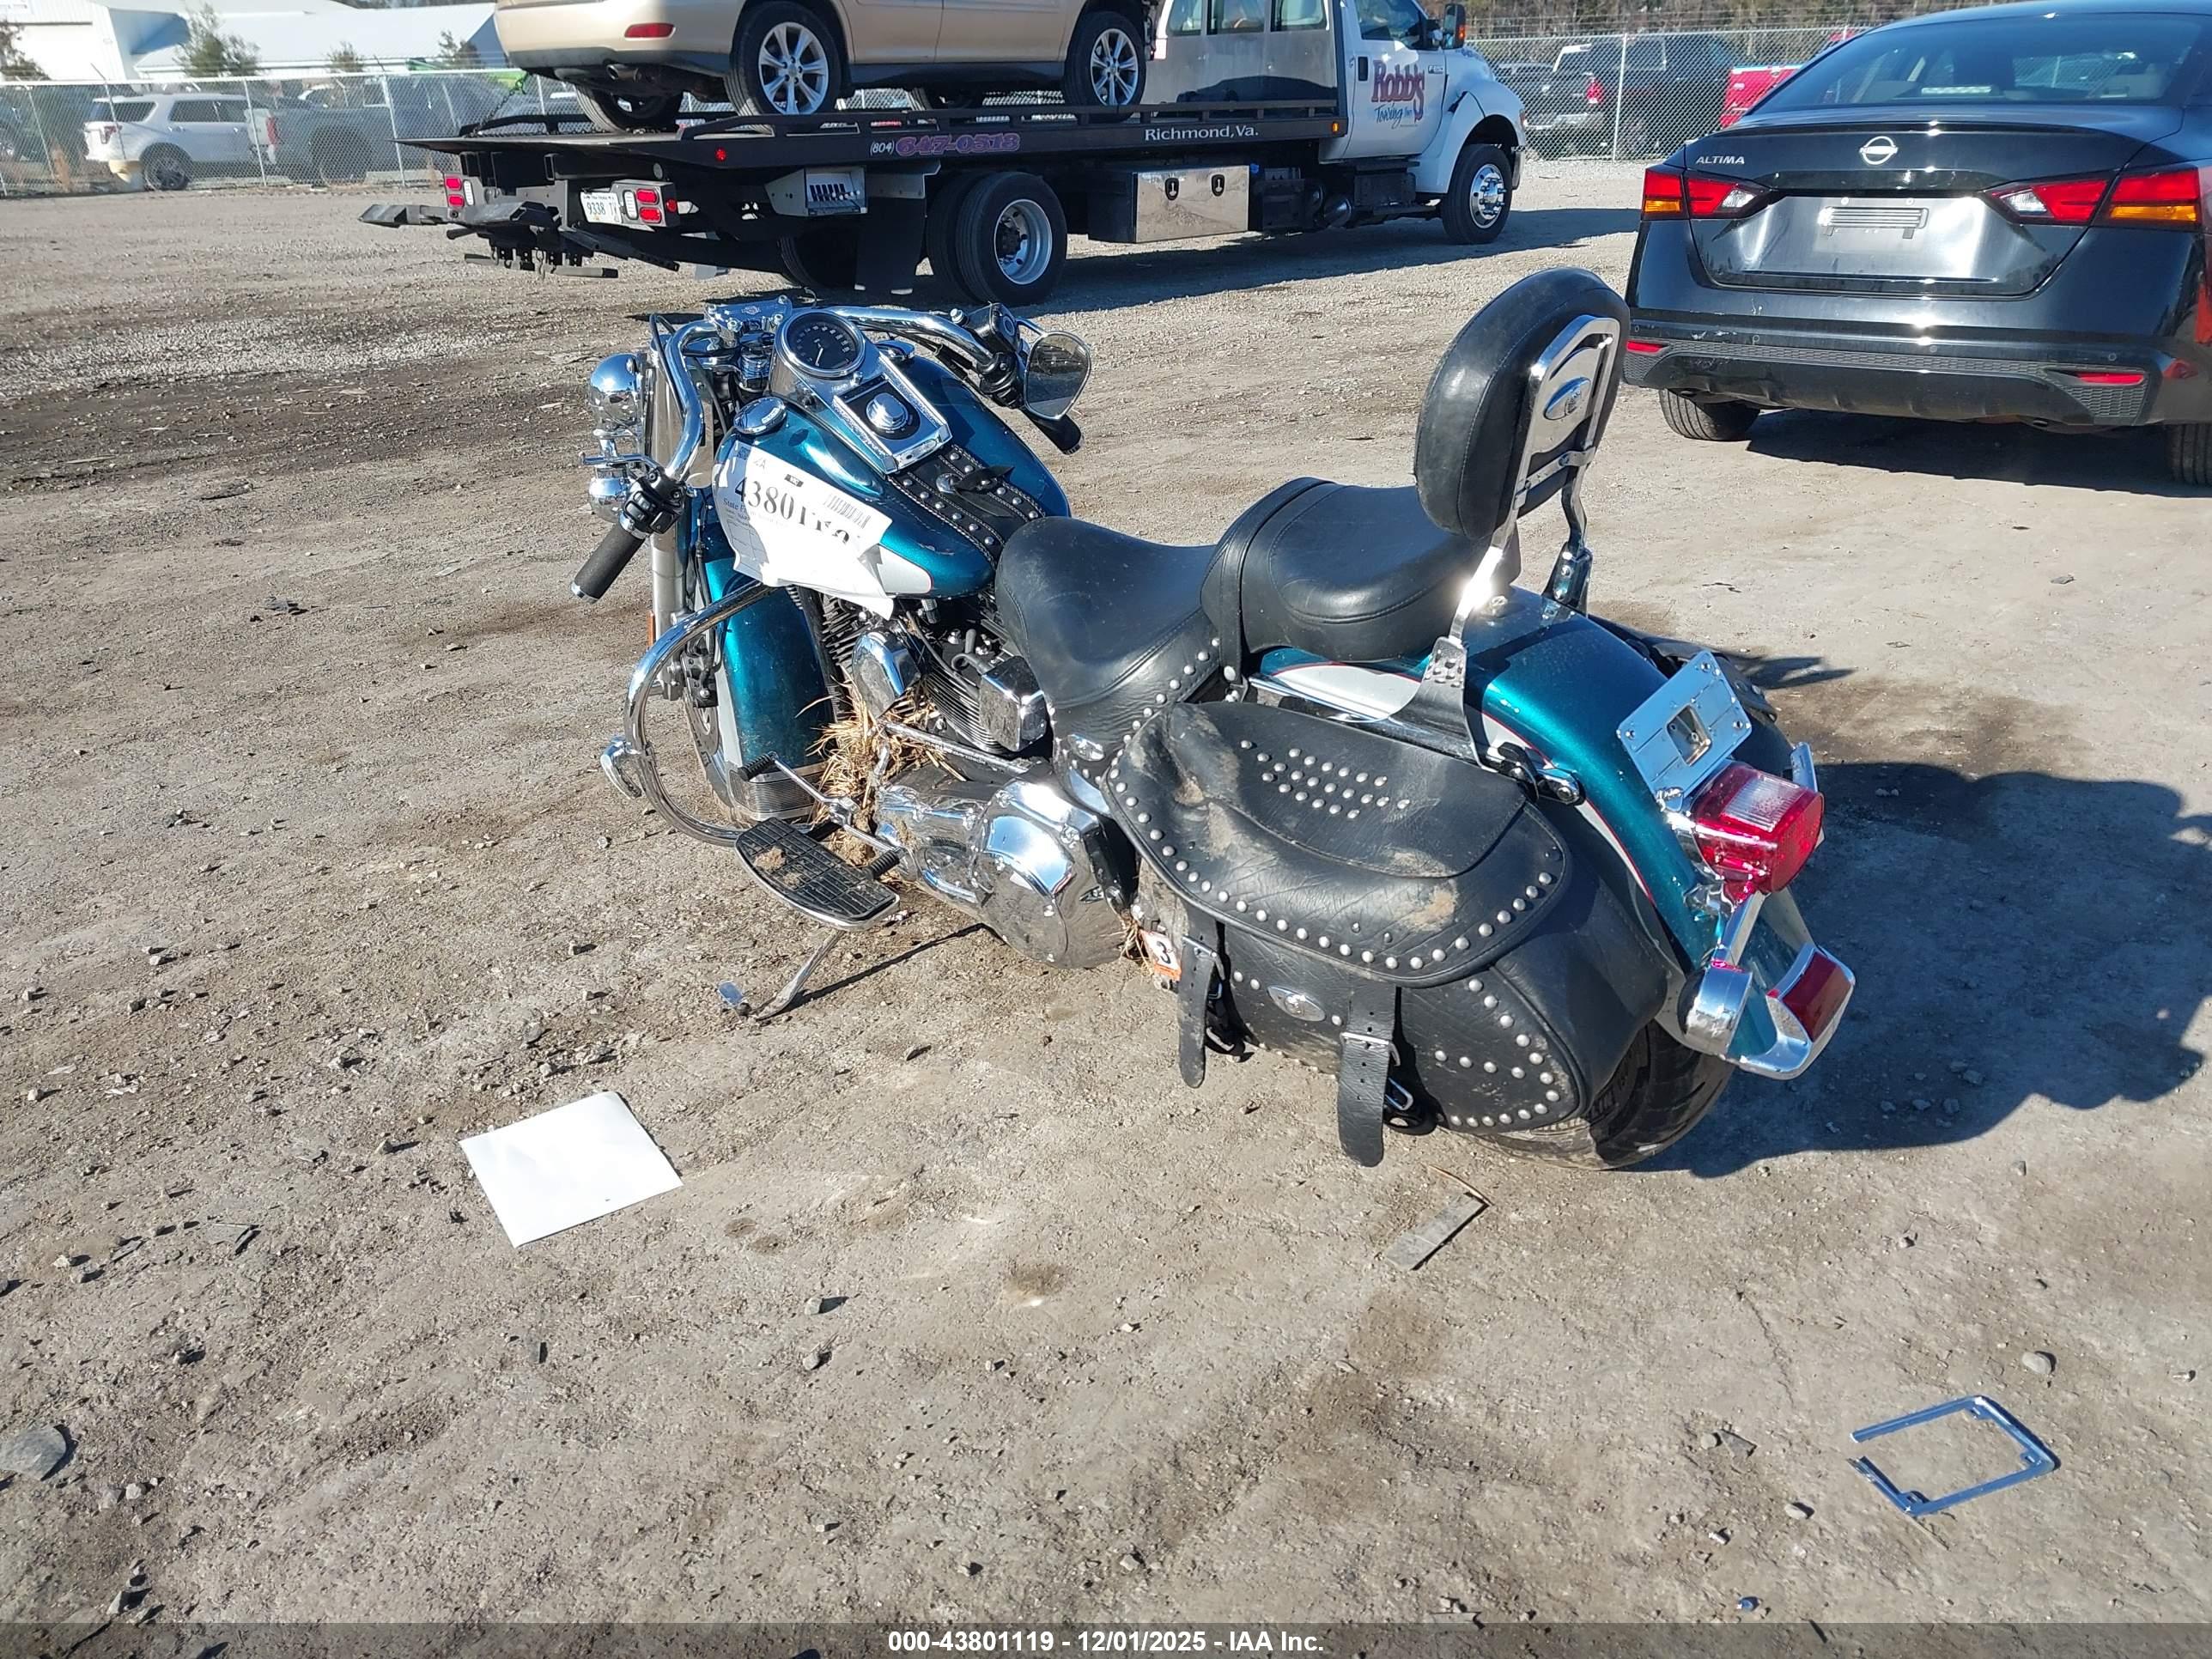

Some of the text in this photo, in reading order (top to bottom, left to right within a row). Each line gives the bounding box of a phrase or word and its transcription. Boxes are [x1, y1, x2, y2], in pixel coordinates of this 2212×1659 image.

[870, 141, 895, 155] (804)
[1695, 155, 1746, 165] ALTIMA
[1157, 940, 1171, 964] 3
